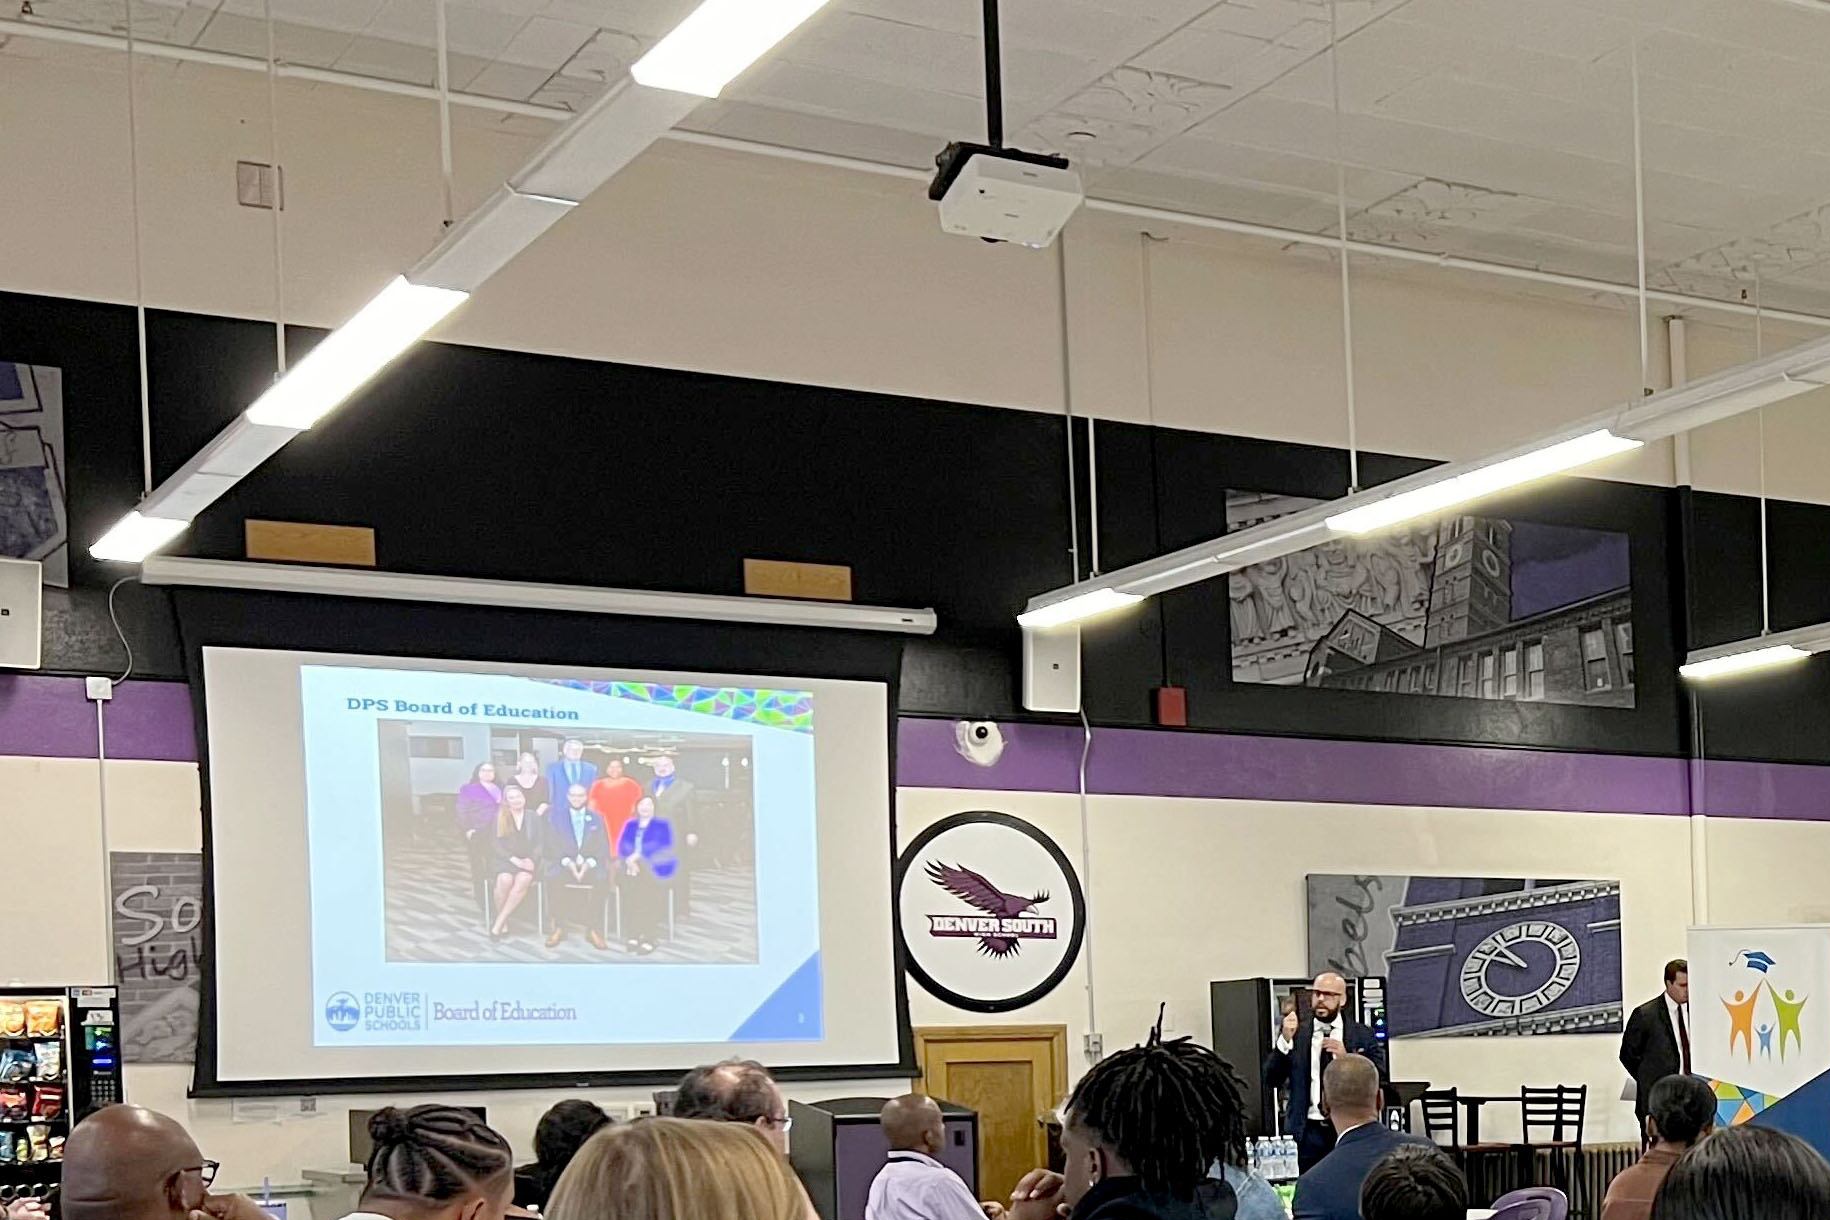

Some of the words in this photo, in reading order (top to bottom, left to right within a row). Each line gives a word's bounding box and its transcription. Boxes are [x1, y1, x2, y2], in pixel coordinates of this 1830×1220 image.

[347, 698, 389, 711] DPS
[395, 700, 452, 714] Board
[458, 703, 477, 716] of
[484, 704, 580, 720] Education
[933, 917, 1000, 932] DENVER
[1001, 919, 1055, 934] SOUTH
[364, 992, 421, 1004] DENVER
[364, 1005, 421, 1018] PUBLIC
[433, 1000, 480, 1021] Board
[483, 1000, 499, 1021] of
[501, 1001, 577, 1021] Education
[364, 1020, 421, 1031] SCHOOLS
